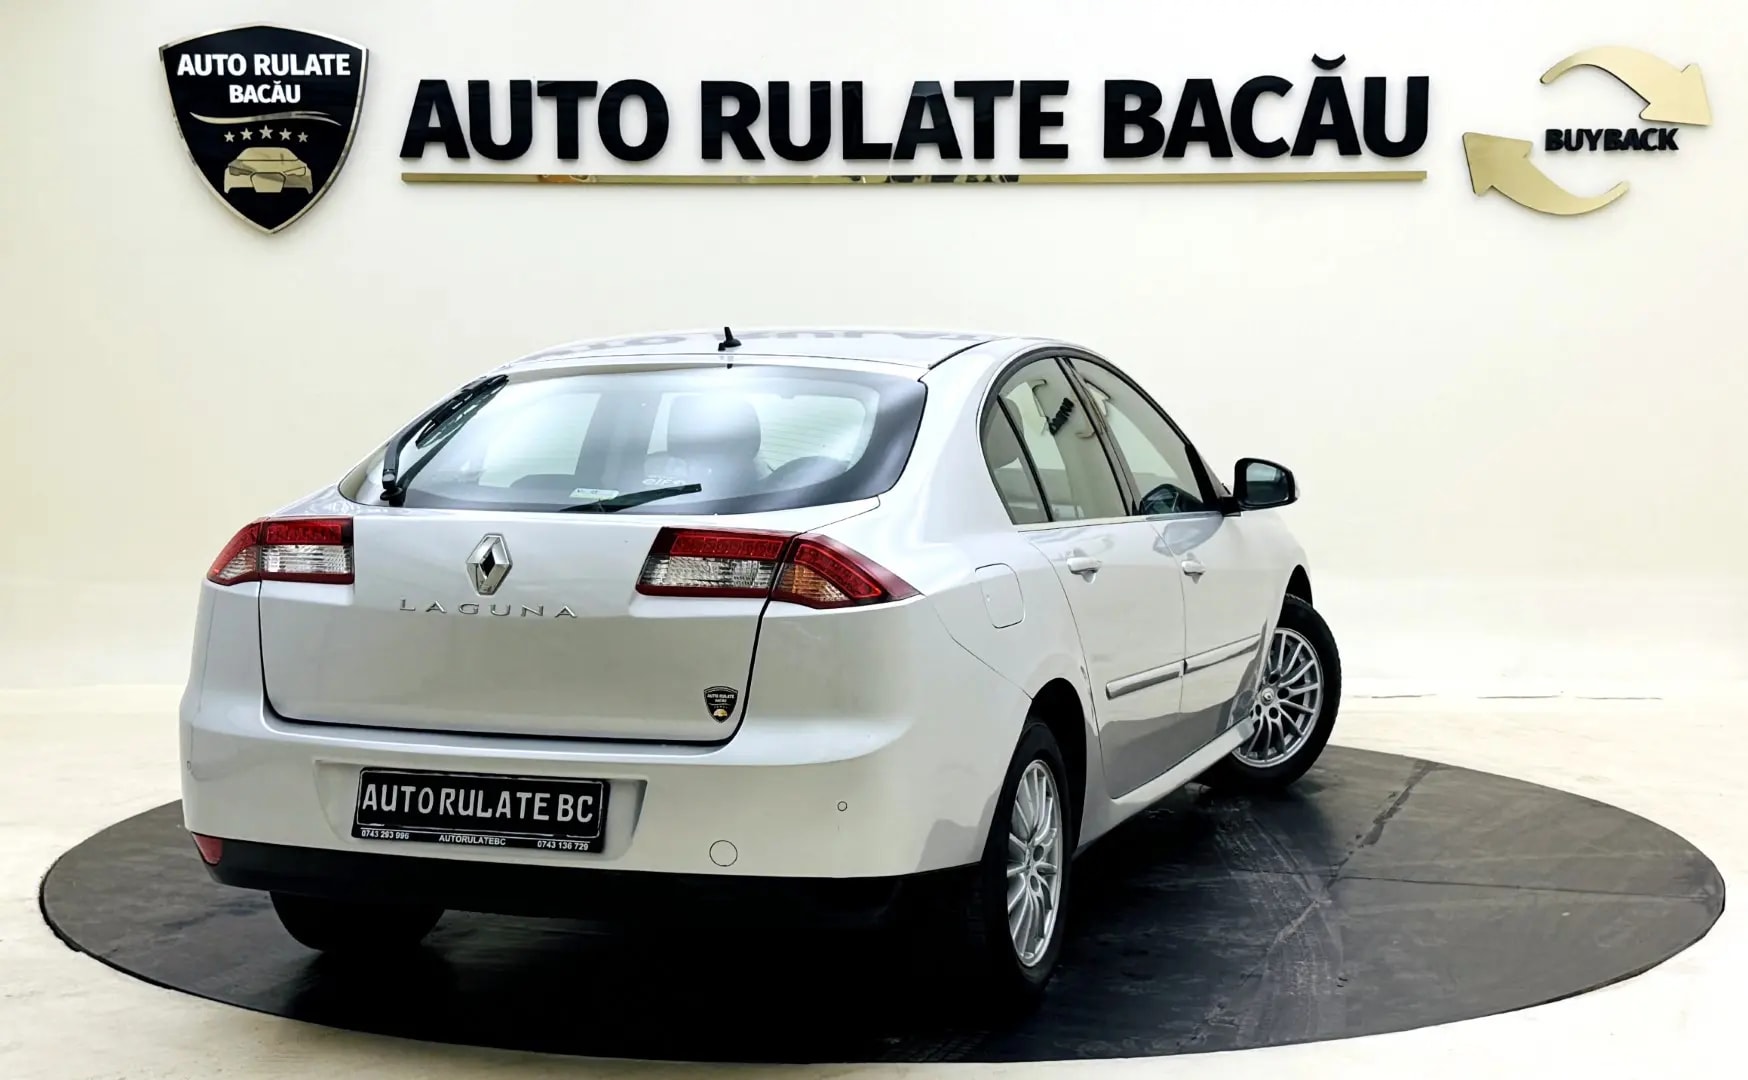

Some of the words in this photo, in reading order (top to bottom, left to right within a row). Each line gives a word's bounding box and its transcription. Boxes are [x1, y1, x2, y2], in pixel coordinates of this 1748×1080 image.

[177, 53, 247, 76] AUTO
[254, 53, 351, 76] RULATE
[229, 80, 301, 104] BACĂU
[400, 79, 669, 161] AUTO
[701, 80, 1069, 161] RULATE
[1103, 53, 1430, 159] BACĂU
[1545, 128, 1679, 152] BUYBACK
[400, 599, 577, 618] LAGUNA
[362, 783, 434, 815] AUTO
[439, 788, 550, 821] RULATE
[556, 793, 593, 823] BC
[361, 829, 379, 838] 0743
[380, 831, 394, 839] 293
[438, 834, 507, 846] AUTORULATEBC
[537, 840, 556, 850] 0743
[558, 842, 573, 851] 136
[574, 842, 589, 851] 729
